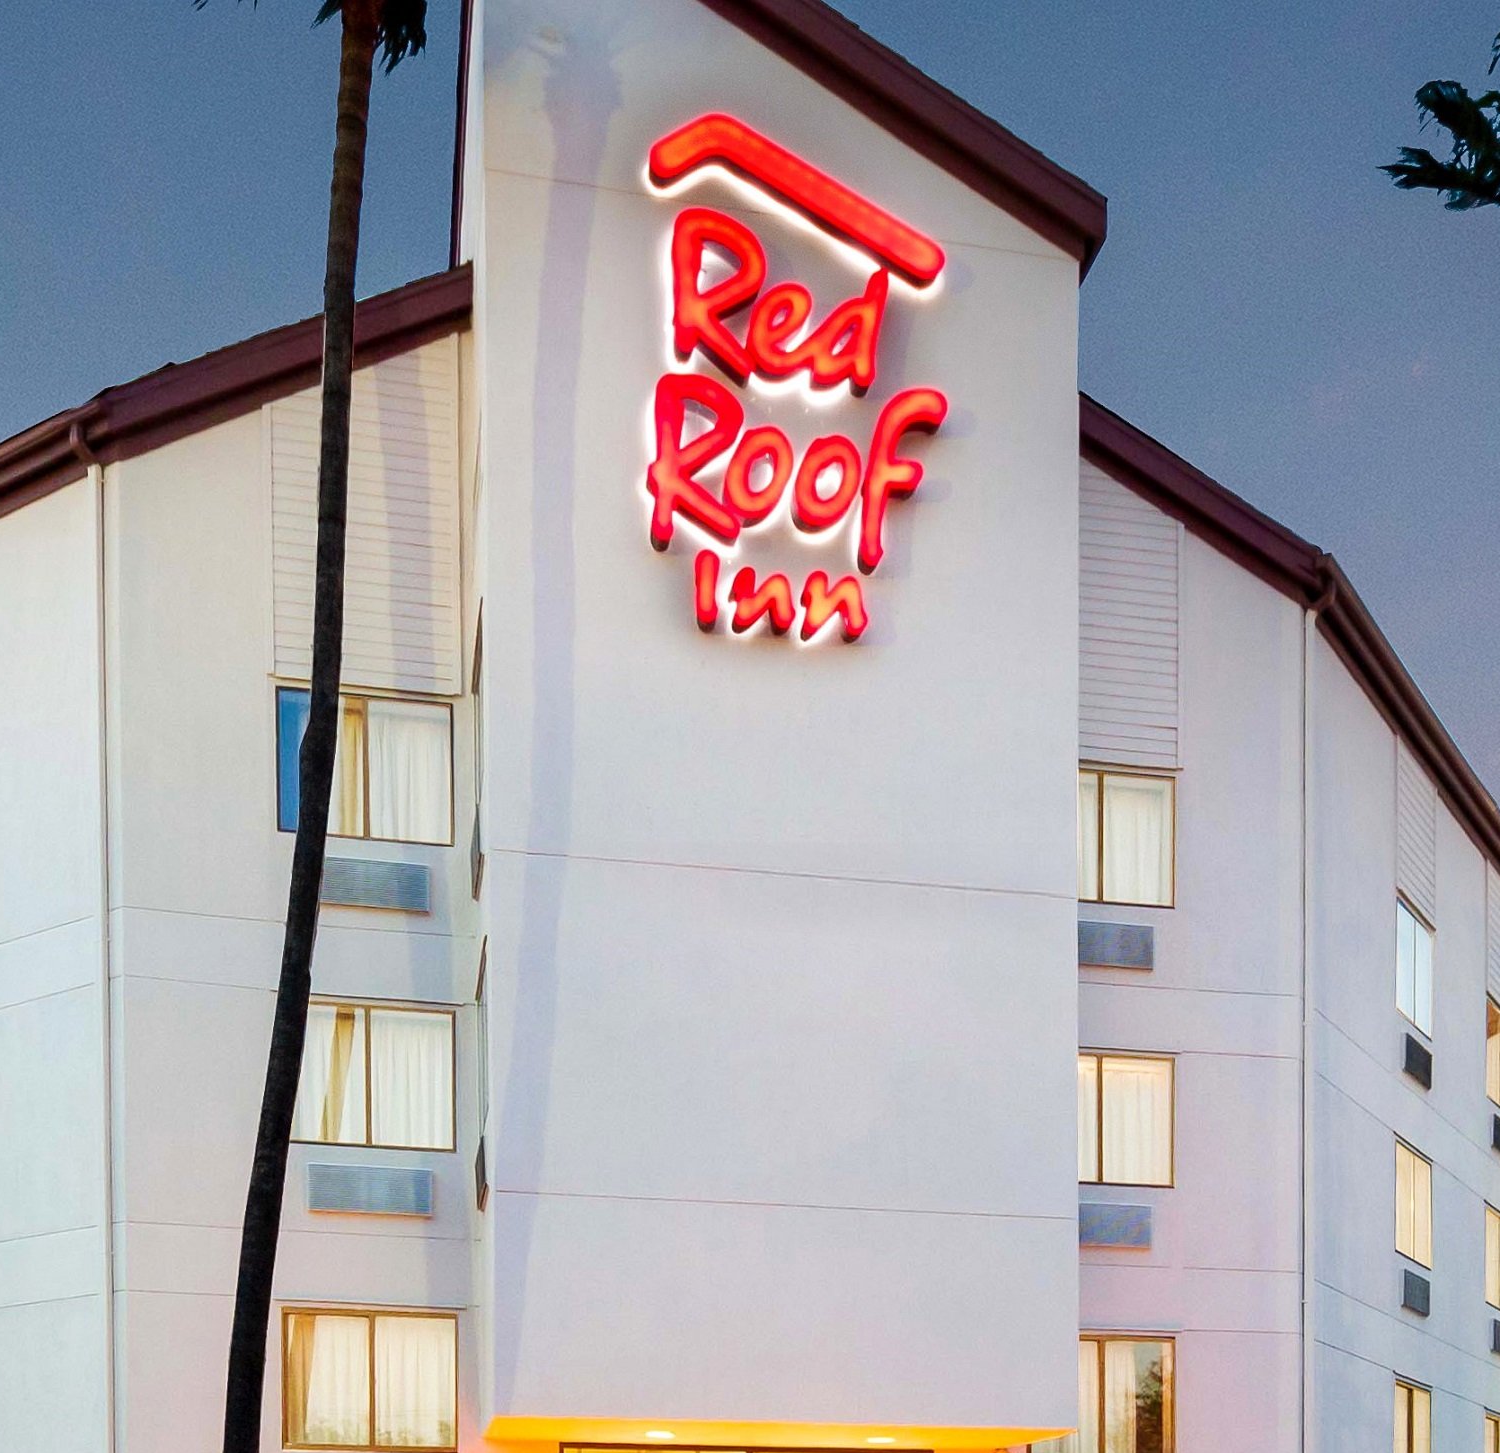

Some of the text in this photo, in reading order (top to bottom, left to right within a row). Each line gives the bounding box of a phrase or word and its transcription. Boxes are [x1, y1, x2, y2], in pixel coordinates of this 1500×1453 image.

[671, 207, 889, 396] Red
[646, 372, 949, 572] Roof
[694, 549, 869, 642] Inn
